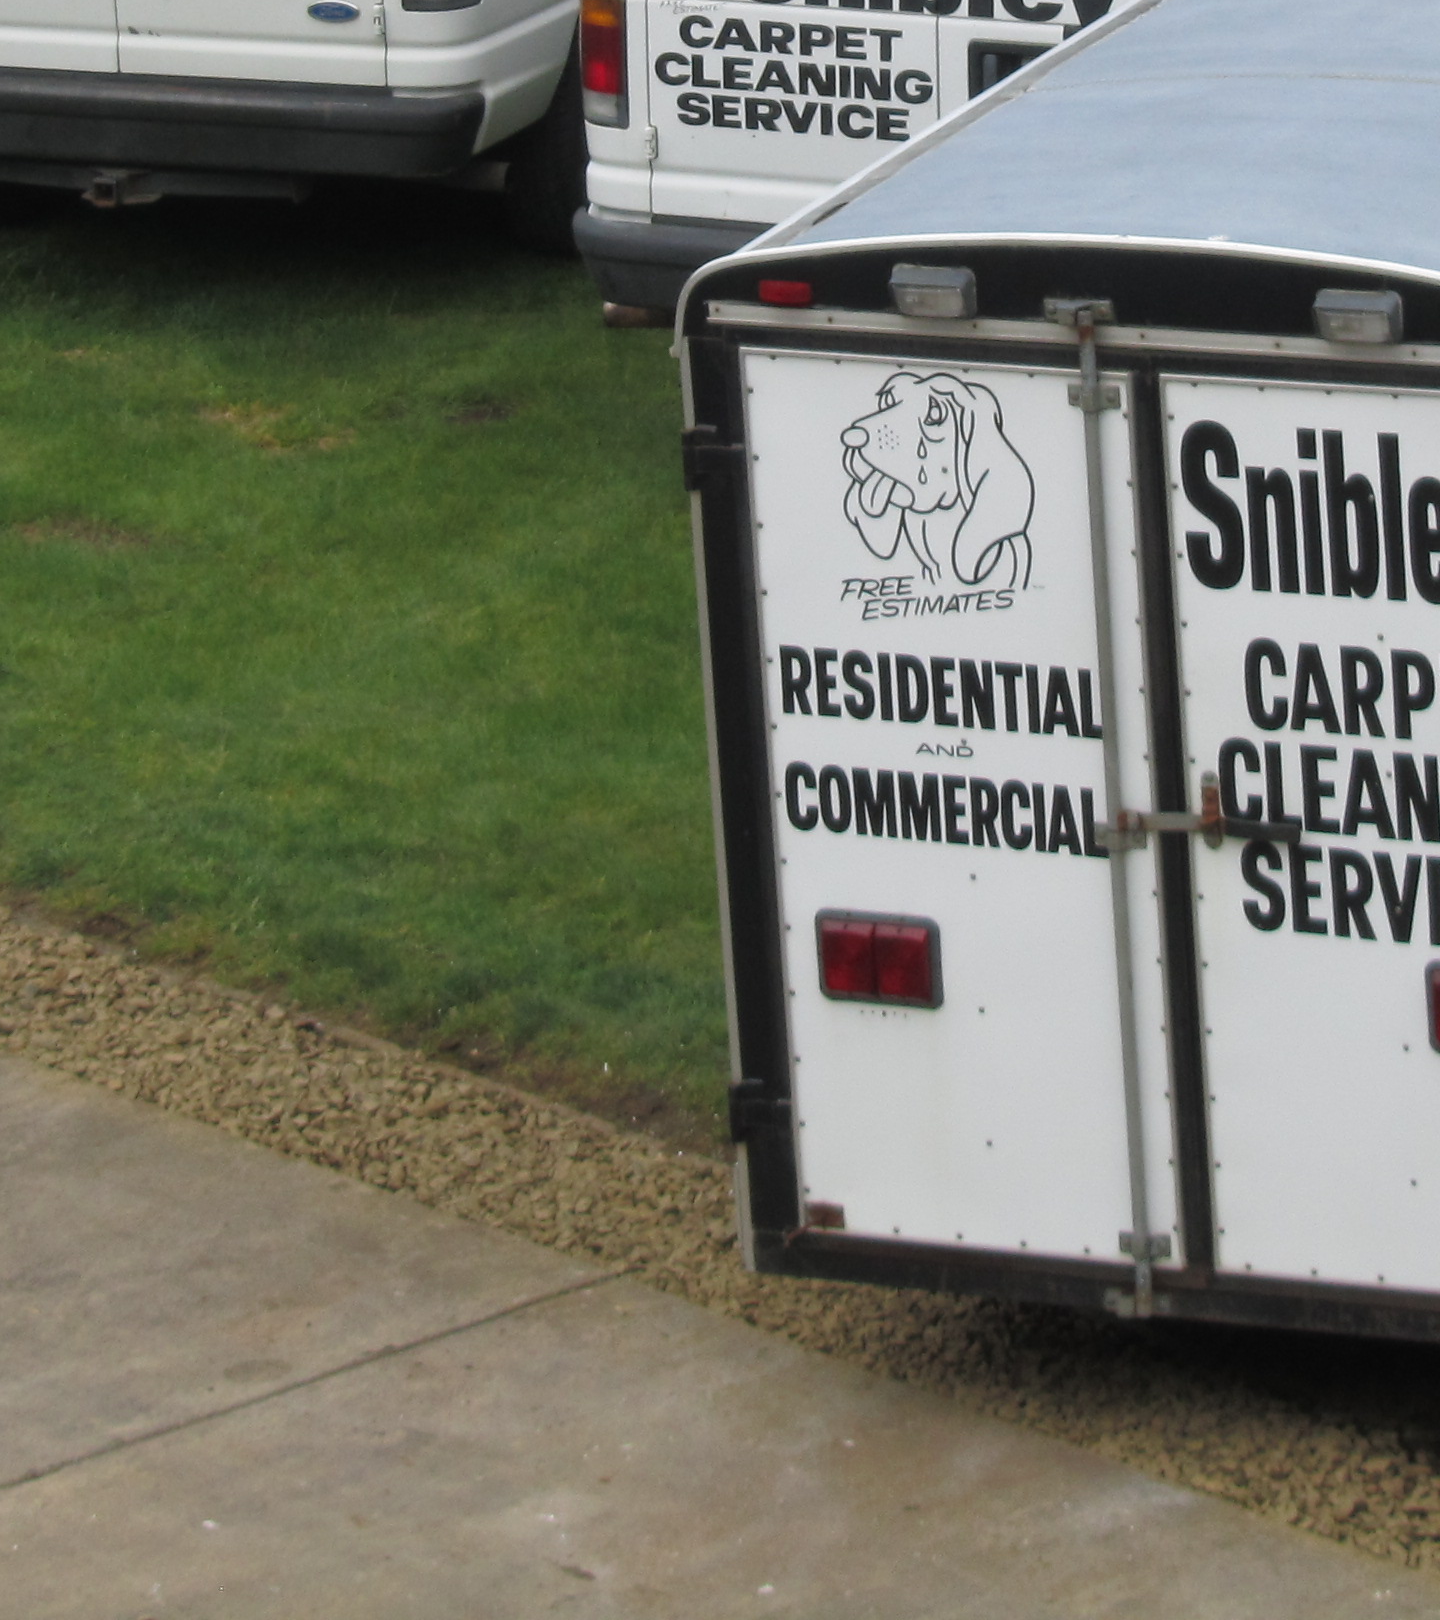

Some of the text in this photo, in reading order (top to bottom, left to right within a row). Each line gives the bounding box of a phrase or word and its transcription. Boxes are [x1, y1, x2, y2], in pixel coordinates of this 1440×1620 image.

[679, 15, 903, 62] CARPET
[655, 52, 933, 104] CLEANING
[677, 92, 910, 141] SERVICE
[840, 576, 914, 601] FREE
[861, 589, 1015, 621] ESTIMATES
[779, 644, 1103, 739] RESIDENTIAL
[916, 742, 974, 758] AND
[785, 761, 1109, 859] COMMERCIAL
